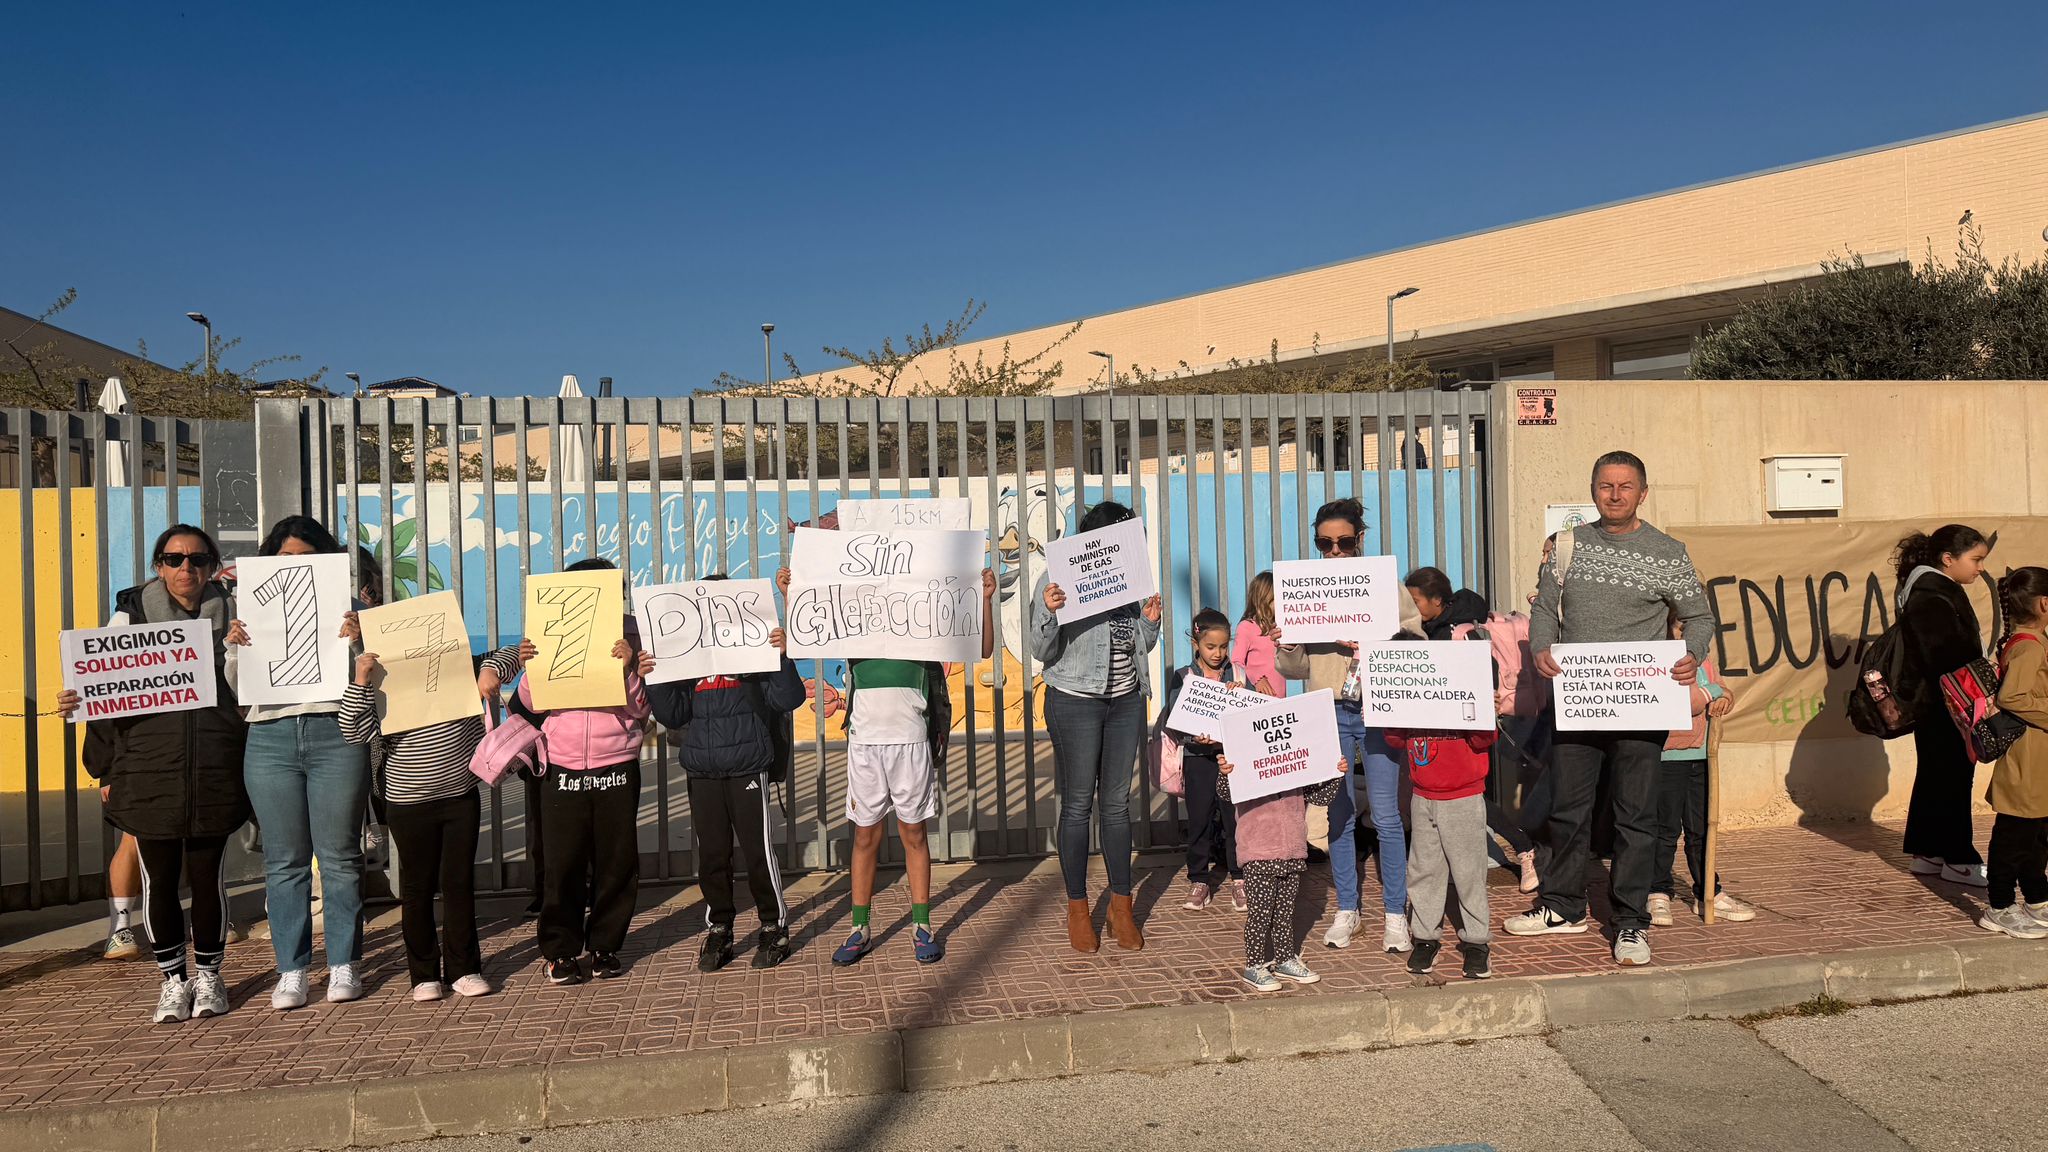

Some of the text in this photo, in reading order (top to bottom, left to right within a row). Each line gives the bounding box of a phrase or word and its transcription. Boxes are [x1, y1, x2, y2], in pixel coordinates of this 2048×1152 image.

[854, 505, 867, 524] A
[1085, 539, 1101, 550] HAY
[839, 533, 914, 577] Sin
[1069, 544, 1120, 566] SUMINISTRO
[1081, 557, 1112, 573] DE GAS
[1088, 570, 1110, 580] FALTA
[1118, 573, 1125, 581] Y
[1282, 574, 1371, 588] NUESTROS HIJOS
[1078, 583, 1128, 604] REPARACIÓN
[1282, 588, 1370, 600] PAGAN VUESTRA
[789, 576, 982, 647] Calefacción
[1283, 602, 1328, 613] FALTA DE
[253, 564, 321, 688] 1
[645, 586, 770, 660] Dias
[1284, 613, 1373, 626] MANTENIMINTO.
[84, 628, 186, 654] EXIGIMOS
[537, 586, 601, 681] 7
[74, 647, 199, 674] SOLUCIÓN YA
[381, 613, 460, 692] 7
[1368, 650, 1429, 662] ¿VUESTROS
[1561, 654, 1656, 665] AYUNTAMIENTO:
[1369, 663, 1436, 674] DESPACHOS
[1562, 665, 1666, 678] VUESTRA GESTIÓN
[84, 670, 194, 698] REPARACIÓN
[1370, 676, 1448, 687] FUNCIONAN?
[1562, 680, 1646, 692] ESTÁ TAN ROTA
[86, 688, 199, 716] INMEDIATA
[1188, 688, 1228, 704] TRABAJA
[1371, 690, 1476, 701] NUESTRA CALDERA
[1564, 694, 1659, 705] COMO NUESTRA
[1184, 696, 1226, 712] ABRIGO?
[1372, 702, 1394, 713] NO.
[1564, 708, 1620, 718] CALDERA.
[1252, 712, 1298, 732] NO ES EL
[1264, 727, 1292, 744] GAS
[1268, 742, 1292, 754] ES LA
[1252, 748, 1310, 770] REPARACIÓN
[1258, 760, 1308, 780] PENDIENTE
[558, 772, 628, 792] Los Angeles
